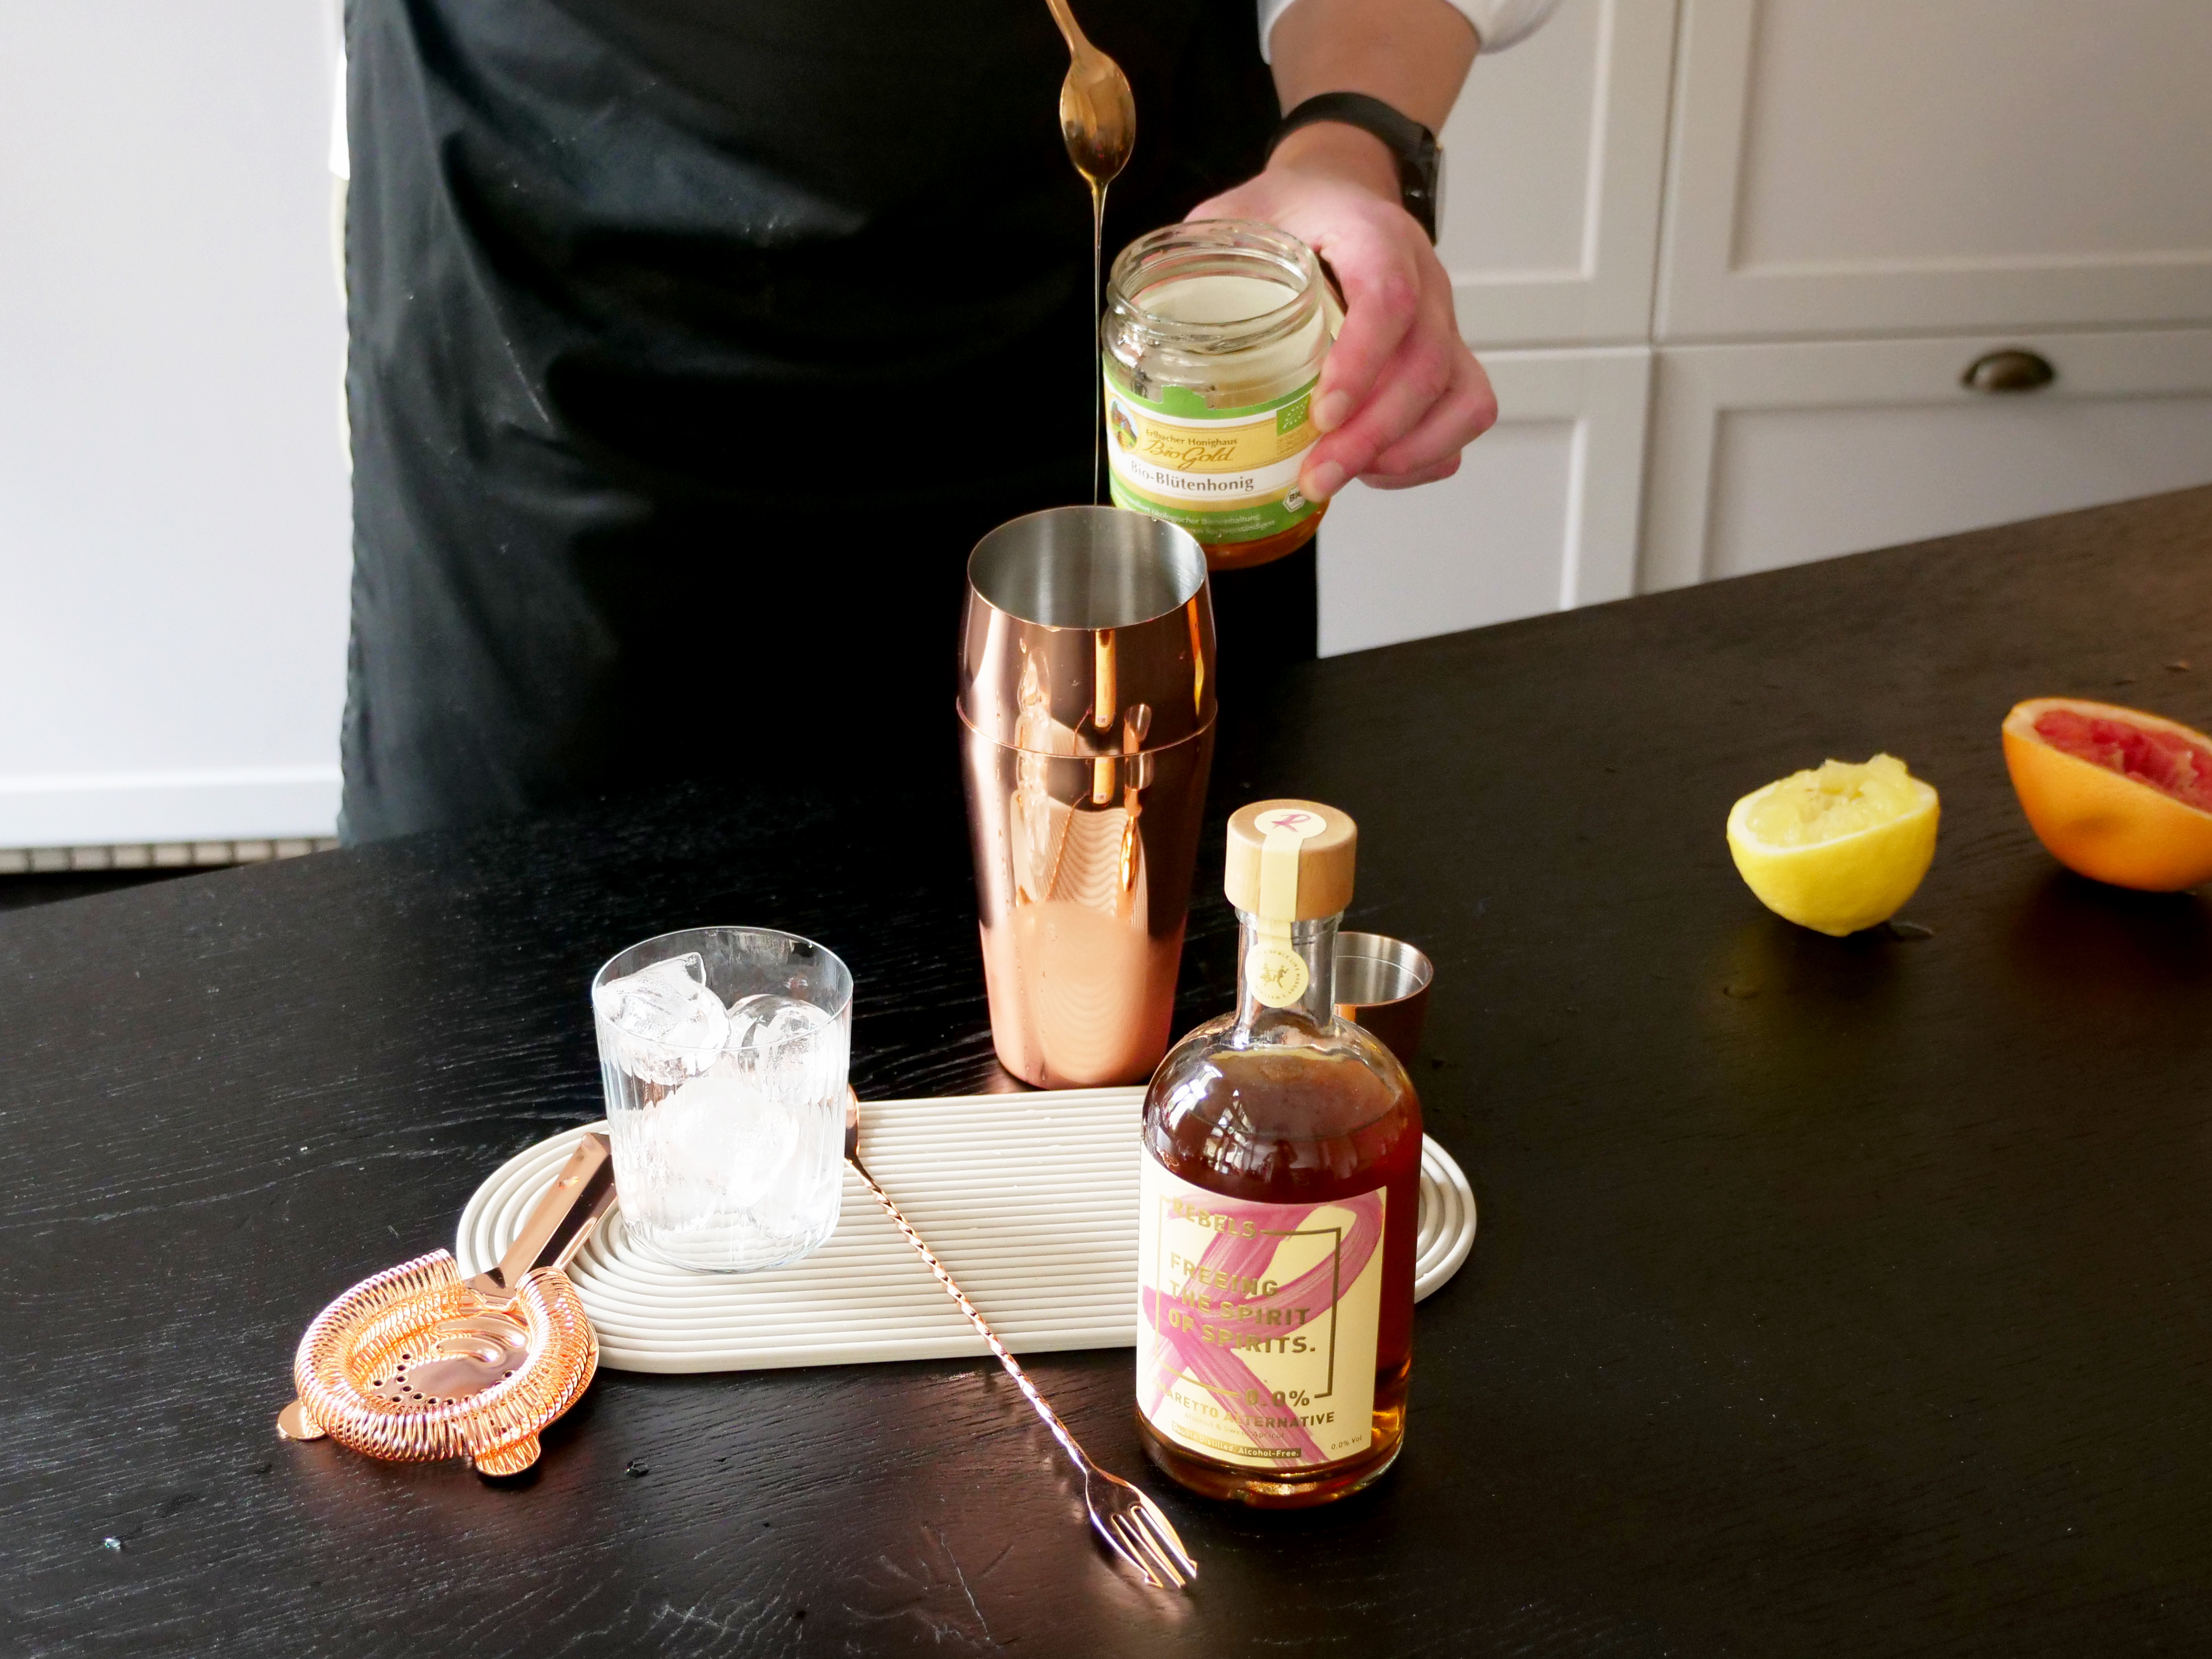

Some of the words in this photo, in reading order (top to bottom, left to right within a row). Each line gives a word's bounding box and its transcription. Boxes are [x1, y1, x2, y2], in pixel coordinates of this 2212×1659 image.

[1142, 440, 1236, 470] BioGold
[1188, 437, 1238, 448] Honighaus
[1131, 460, 1254, 491] Bio-Blütenhonig
[1173, 1196, 1257, 1240] REBELS
[1171, 1252, 1278, 1297] FREEING
[1169, 1279, 1211, 1314] THE
[1220, 1301, 1310, 1325] SPIRIT
[1168, 1307, 1194, 1333] OF
[1202, 1324, 1315, 1353] SPIRITS.
[1245, 1389, 1310, 1408] 0.0%
[1184, 1412, 1213, 1427] Almond
[1223, 1411, 1335, 1428] ALTERNATIVE
[1173, 1423, 1197, 1440] Double
[1239, 1447, 1299, 1457] Alcohol-Free.
[1331, 1440, 1349, 1450] 0.0%
[1351, 1435, 1363, 1444] Vol
